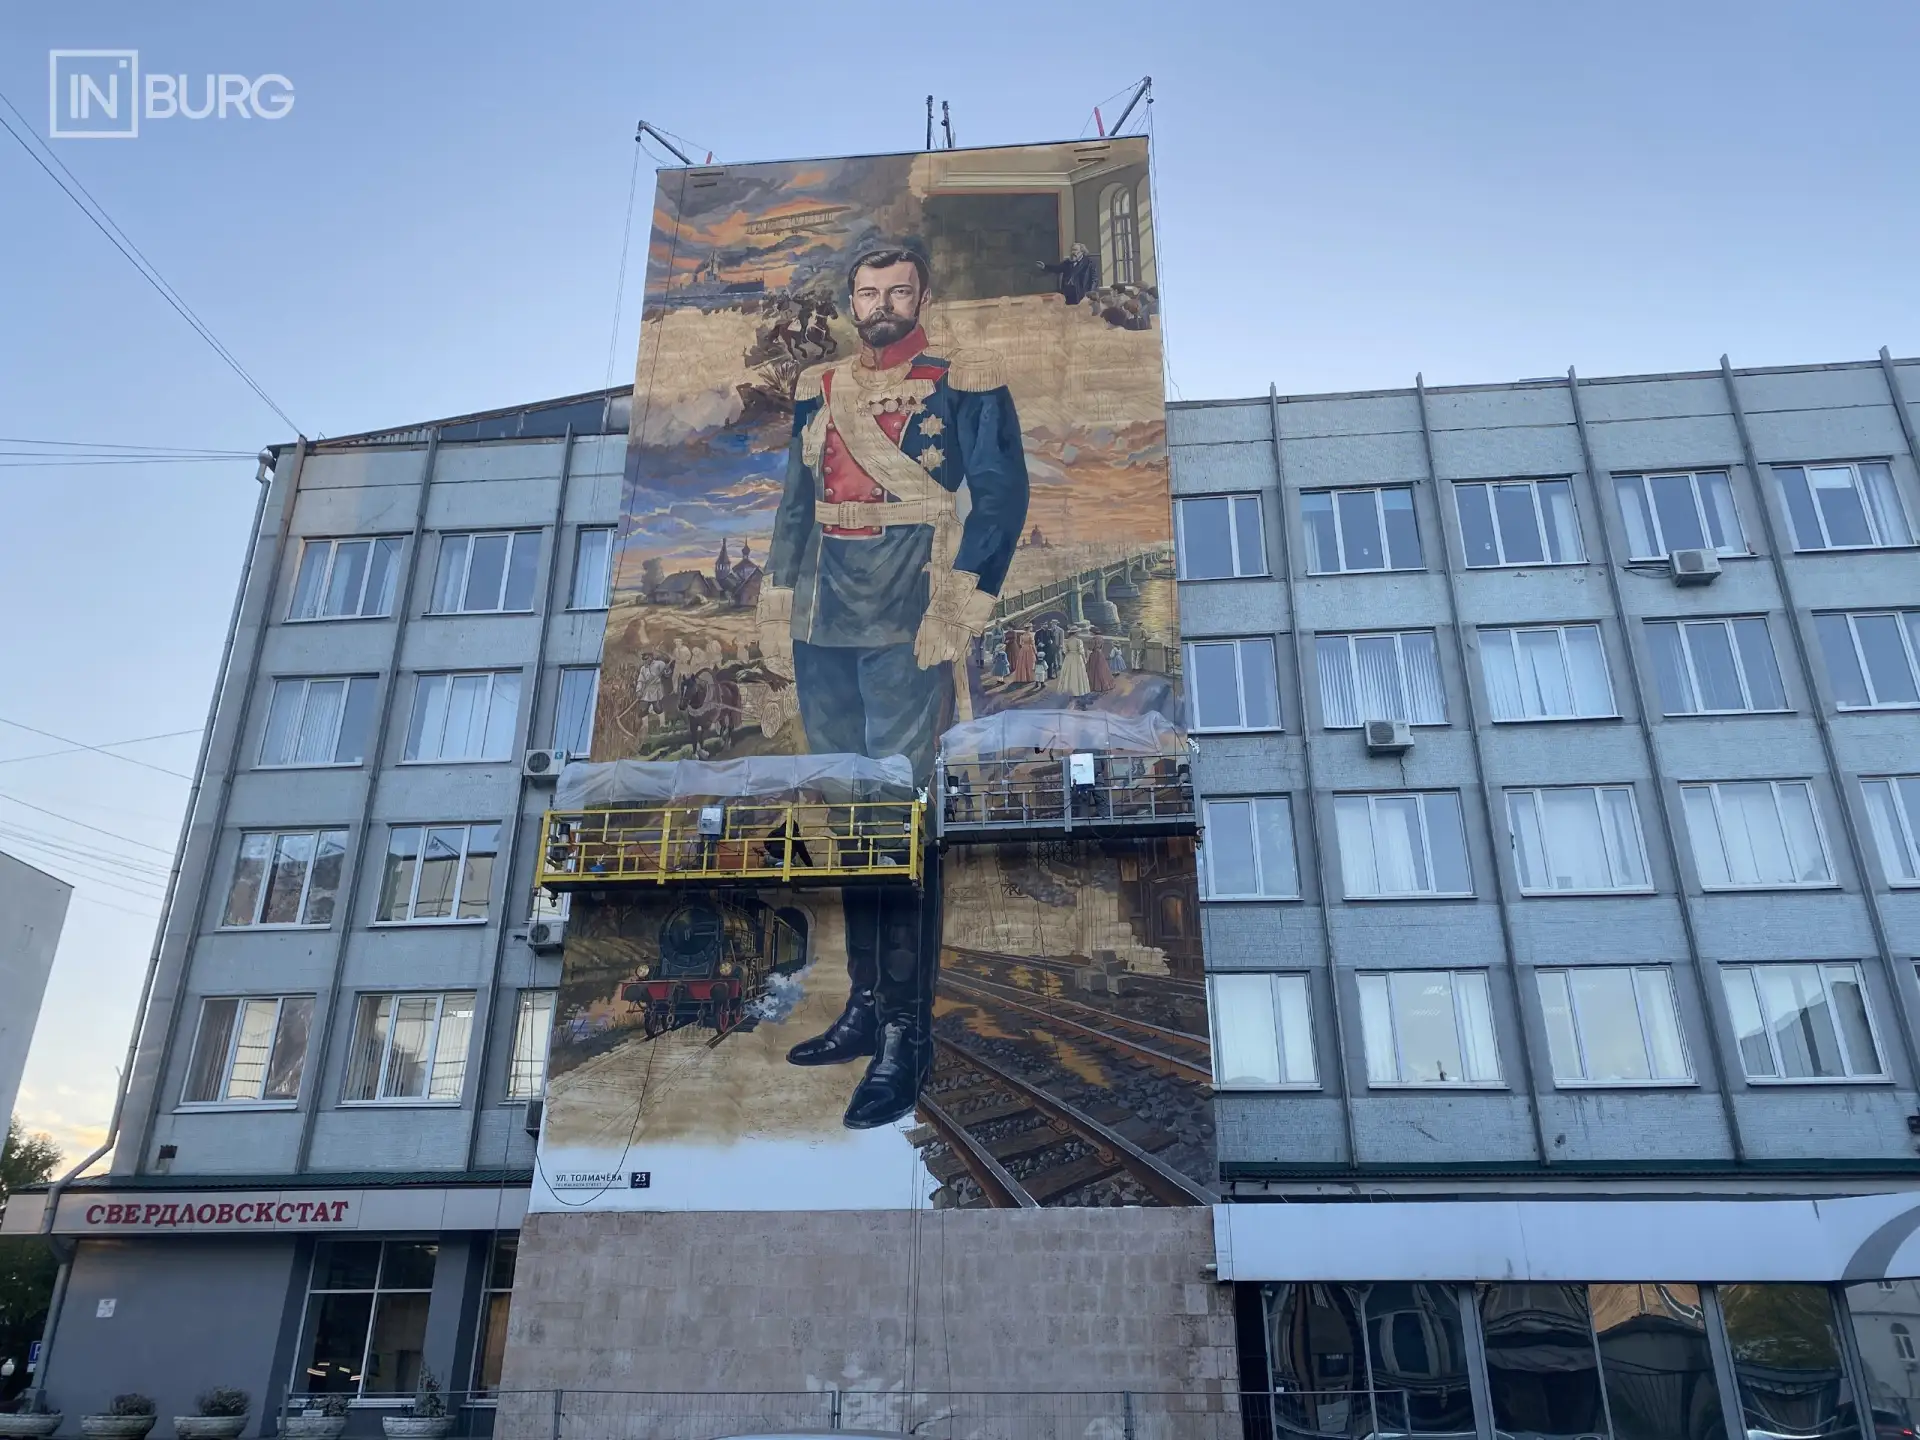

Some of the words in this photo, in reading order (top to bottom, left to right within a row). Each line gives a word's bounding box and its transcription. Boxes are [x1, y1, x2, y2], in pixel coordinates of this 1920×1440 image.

[571, 1173, 622, 1182] ТОЛМАЧЁВА
[635, 1173, 646, 1182] 23
[86, 1201, 349, 1228] СВЕРДЛОВСКСТАТ
